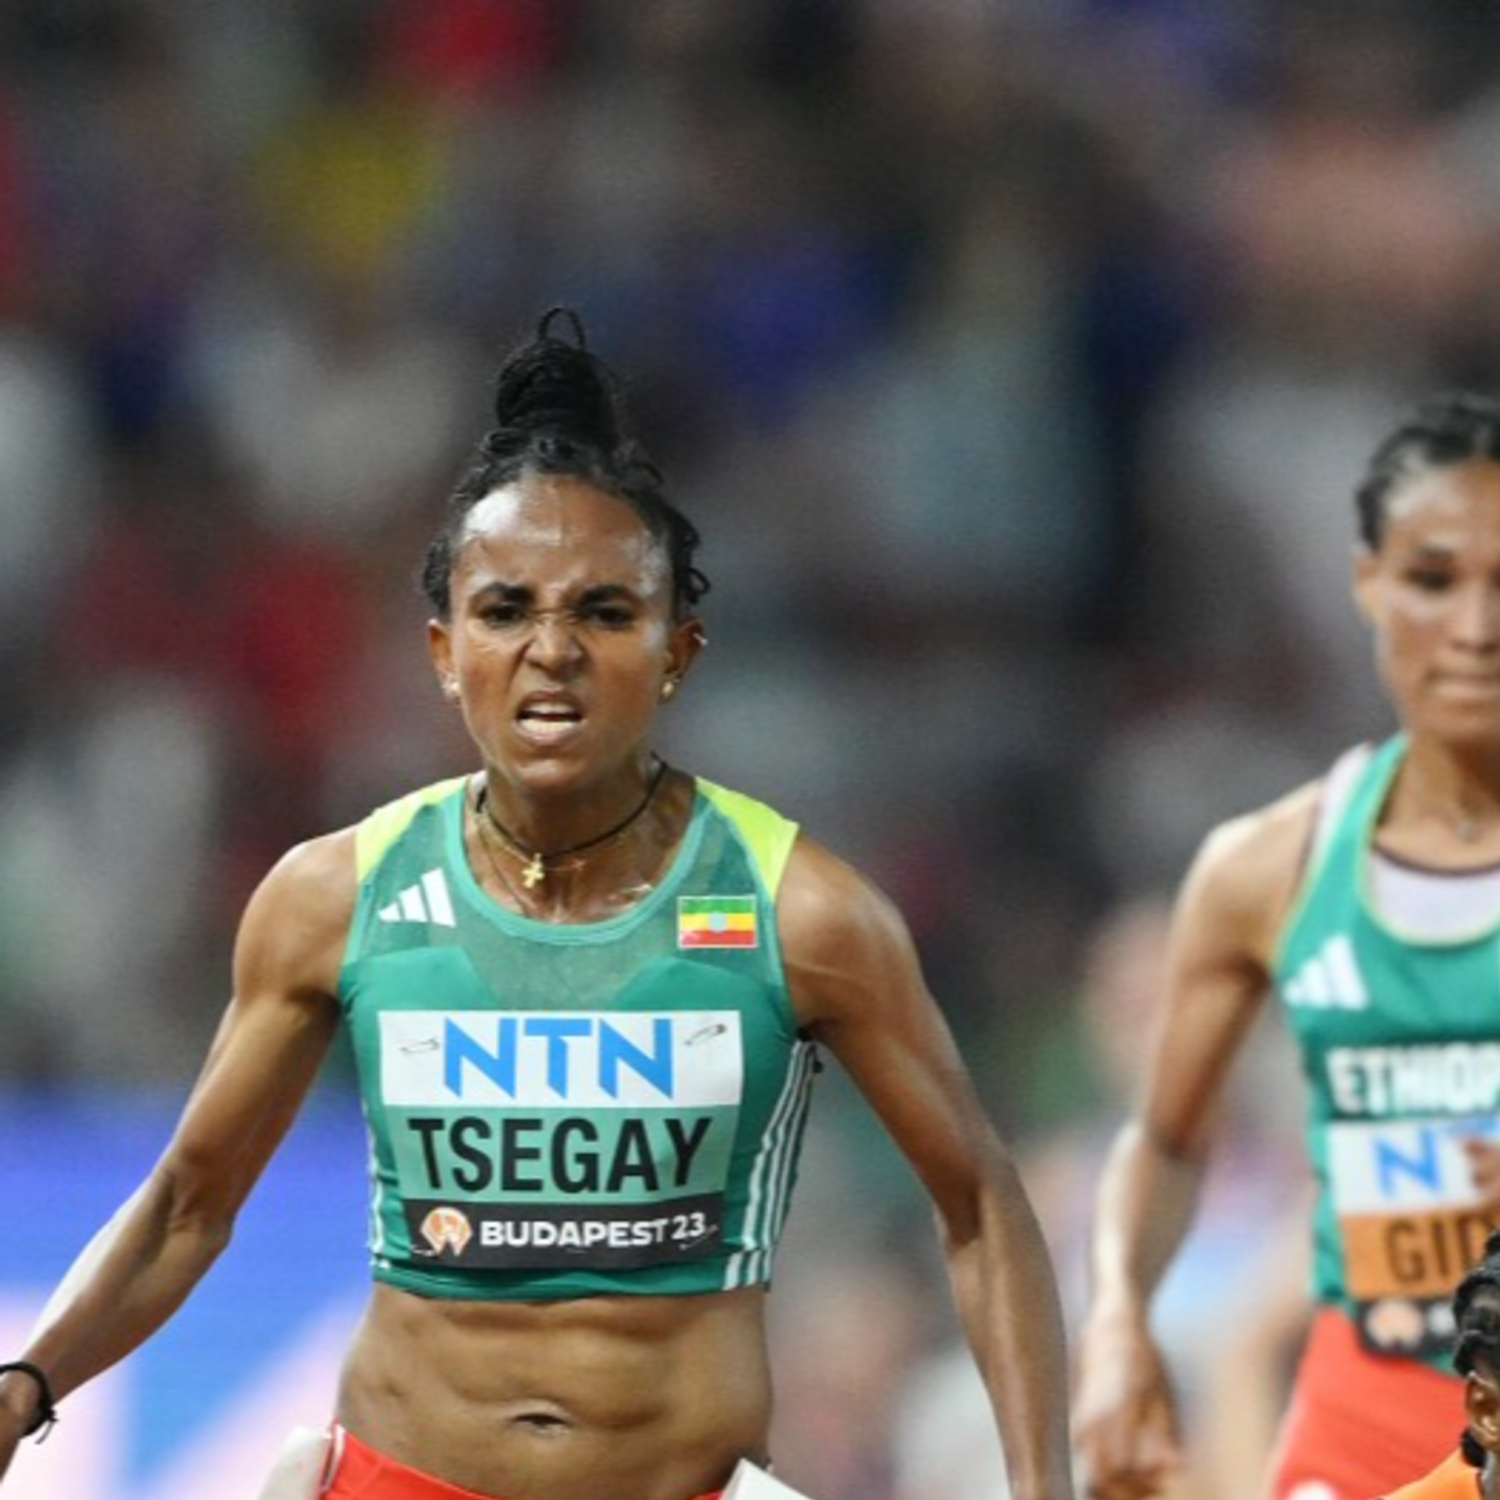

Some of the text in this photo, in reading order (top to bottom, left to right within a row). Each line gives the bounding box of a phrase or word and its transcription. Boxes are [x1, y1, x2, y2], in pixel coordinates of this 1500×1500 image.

[443, 1017, 673, 1100] NTN
[406, 1117, 712, 1194] TSEGAY
[480, 1212, 706, 1248] BUDAPEST 23
